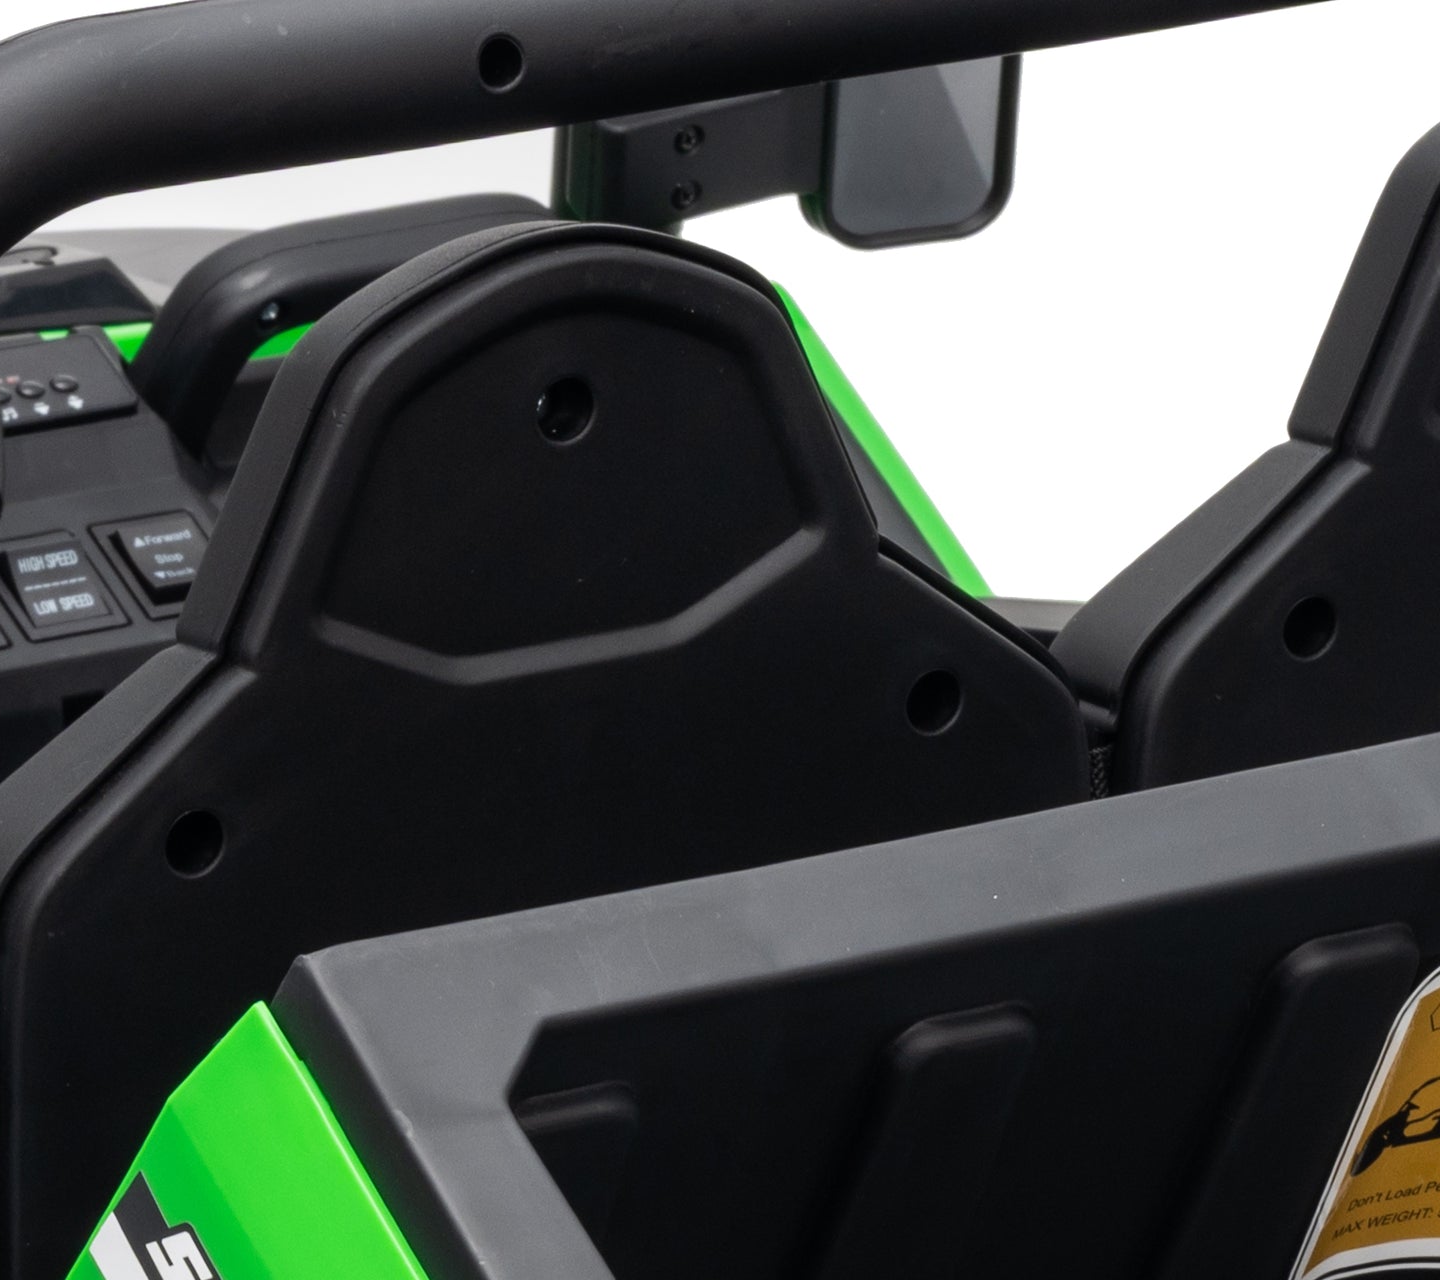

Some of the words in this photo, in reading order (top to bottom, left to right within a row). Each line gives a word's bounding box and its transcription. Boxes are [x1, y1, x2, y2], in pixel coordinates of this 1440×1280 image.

[17, 553, 46, 573] HIGH
[46, 549, 79, 569] SPEED
[33, 598, 58, 616] LOW
[59, 593, 95, 611] SPEED
[1347, 1192, 1383, 1212] Don't
[1385, 1184, 1422, 1201] Load
[1331, 1219, 1365, 1241] MAX
[1367, 1206, 1434, 1229] WEIGHT:
